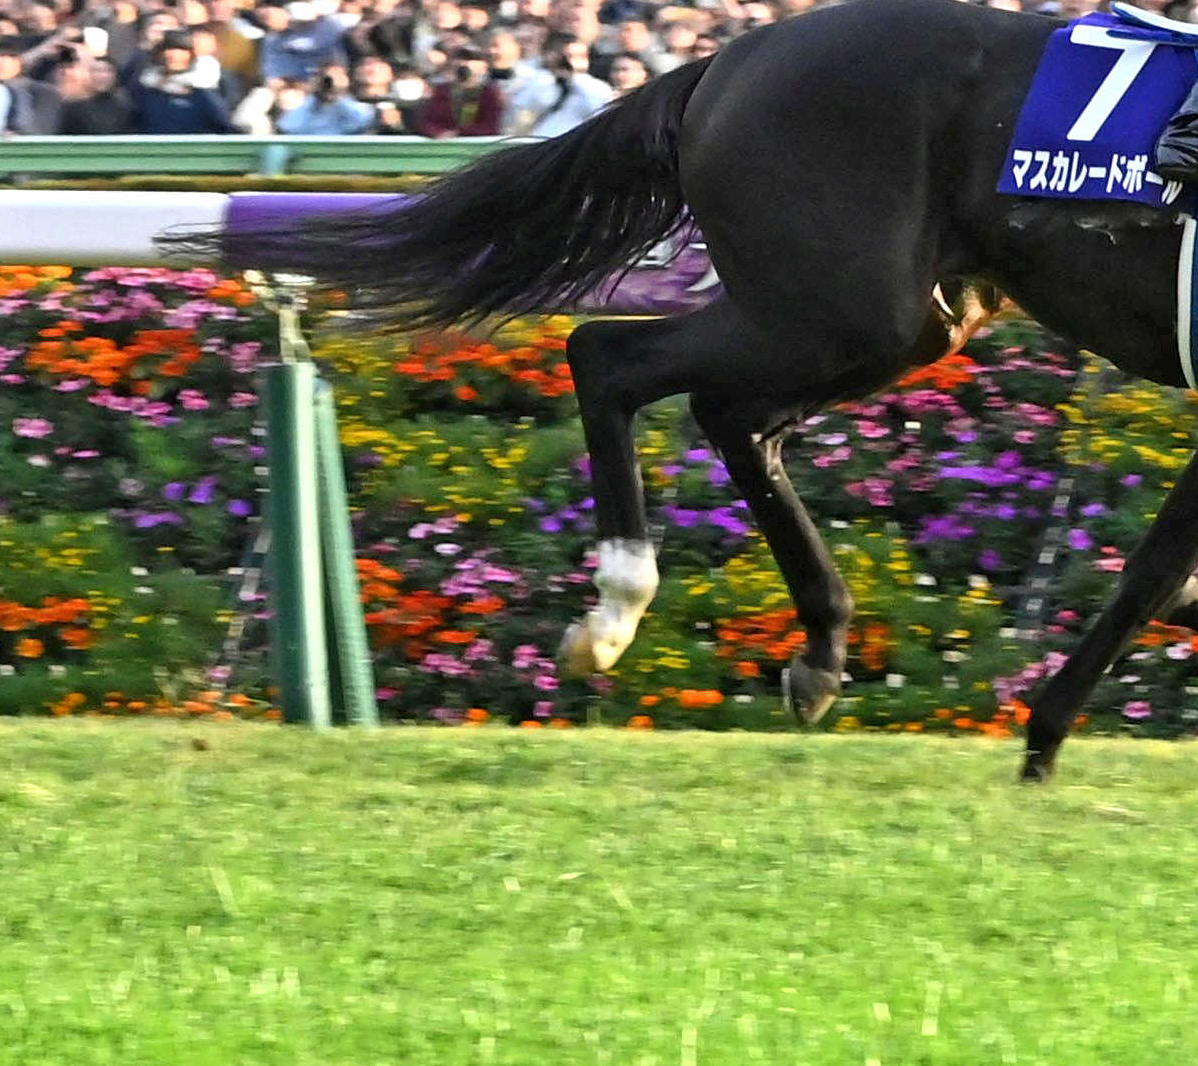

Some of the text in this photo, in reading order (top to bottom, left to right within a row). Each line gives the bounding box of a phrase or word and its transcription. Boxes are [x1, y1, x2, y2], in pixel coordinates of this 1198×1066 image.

[1066, 24, 1158, 142] 7
[1012, 149, 1183, 205] マスカレードボール
